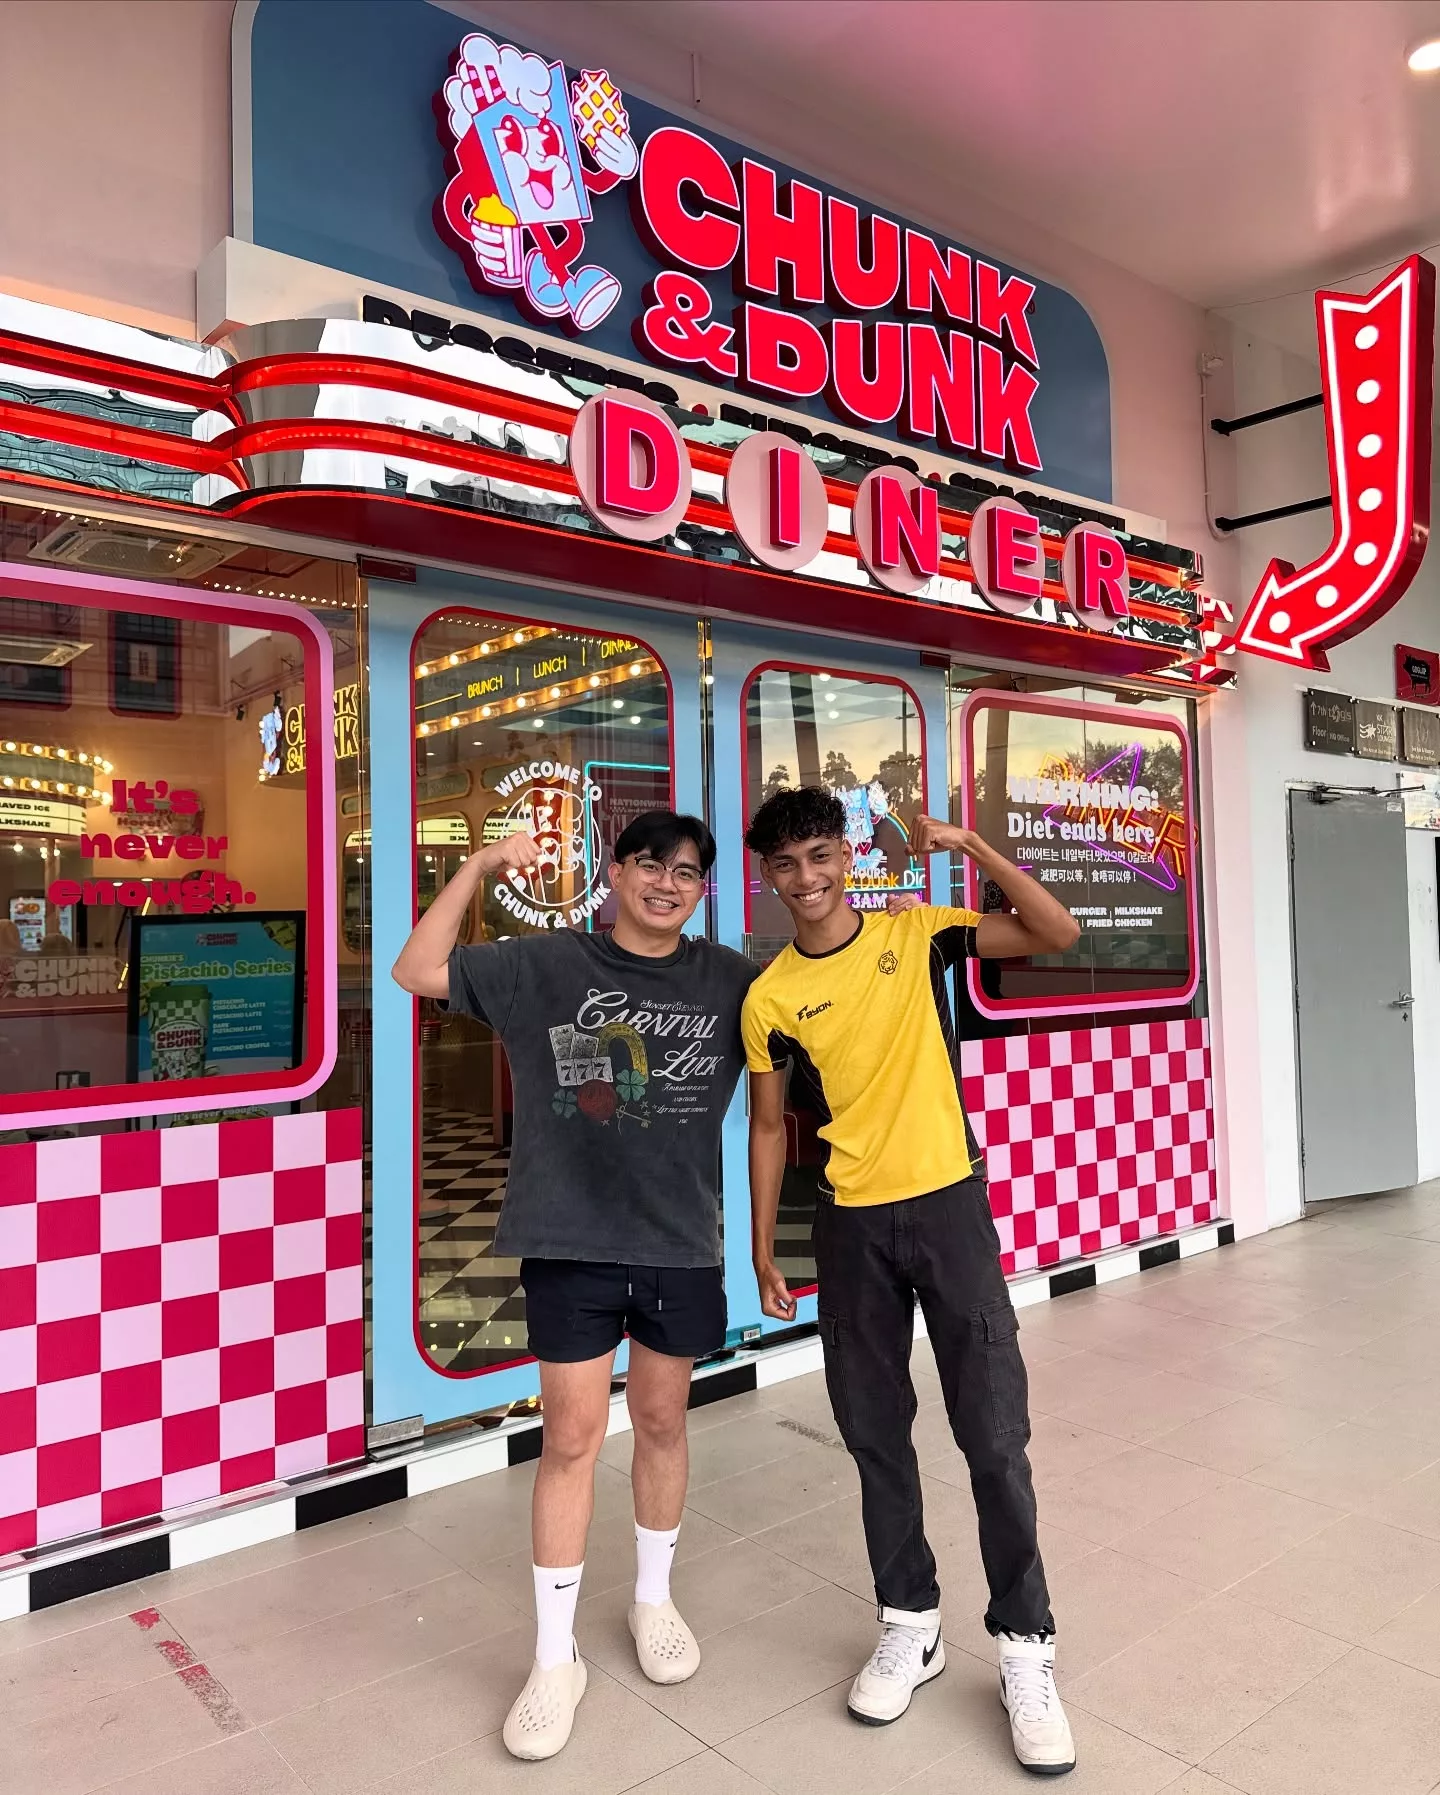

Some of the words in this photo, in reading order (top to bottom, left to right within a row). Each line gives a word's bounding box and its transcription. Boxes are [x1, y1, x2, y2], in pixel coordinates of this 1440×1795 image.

[640, 127, 1040, 370] CHUNK
[467, 675, 503, 698] BRUNCH
[533, 656, 567, 678] LUNCH
[494, 760, 581, 798] WELCOME
[581, 776, 603, 802] TO
[1007, 776, 1160, 812] WARNING:
[34, 804, 50, 812] ICE
[112, 779, 201, 815] It's
[1007, 812, 1055, 841] Diet
[1060, 816, 1107, 842] ends
[80, 832, 230, 860] never
[1016, 847, 1060, 862] 다이어트는
[48, 870, 257, 914] enough.
[494, 884, 550, 929] CHUNK
[553, 911, 568, 929] &
[569, 881, 612, 925] DUNK
[851, 893, 888, 909] 3AM
[1069, 907, 1108, 916] BURGER
[1114, 906, 1163, 916] MILKSHAKE
[1086, 918, 1113, 928] FRIED
[1114, 918, 1153, 928] CHICKEN
[15, 958, 119, 982] CHUNK
[140, 961, 231, 981] Pistachio
[235, 958, 294, 977] Series
[576, 988, 719, 1039] CARNIVAL
[157, 1029, 201, 1041] CHUNK
[651, 1041, 724, 1082] LUCK
